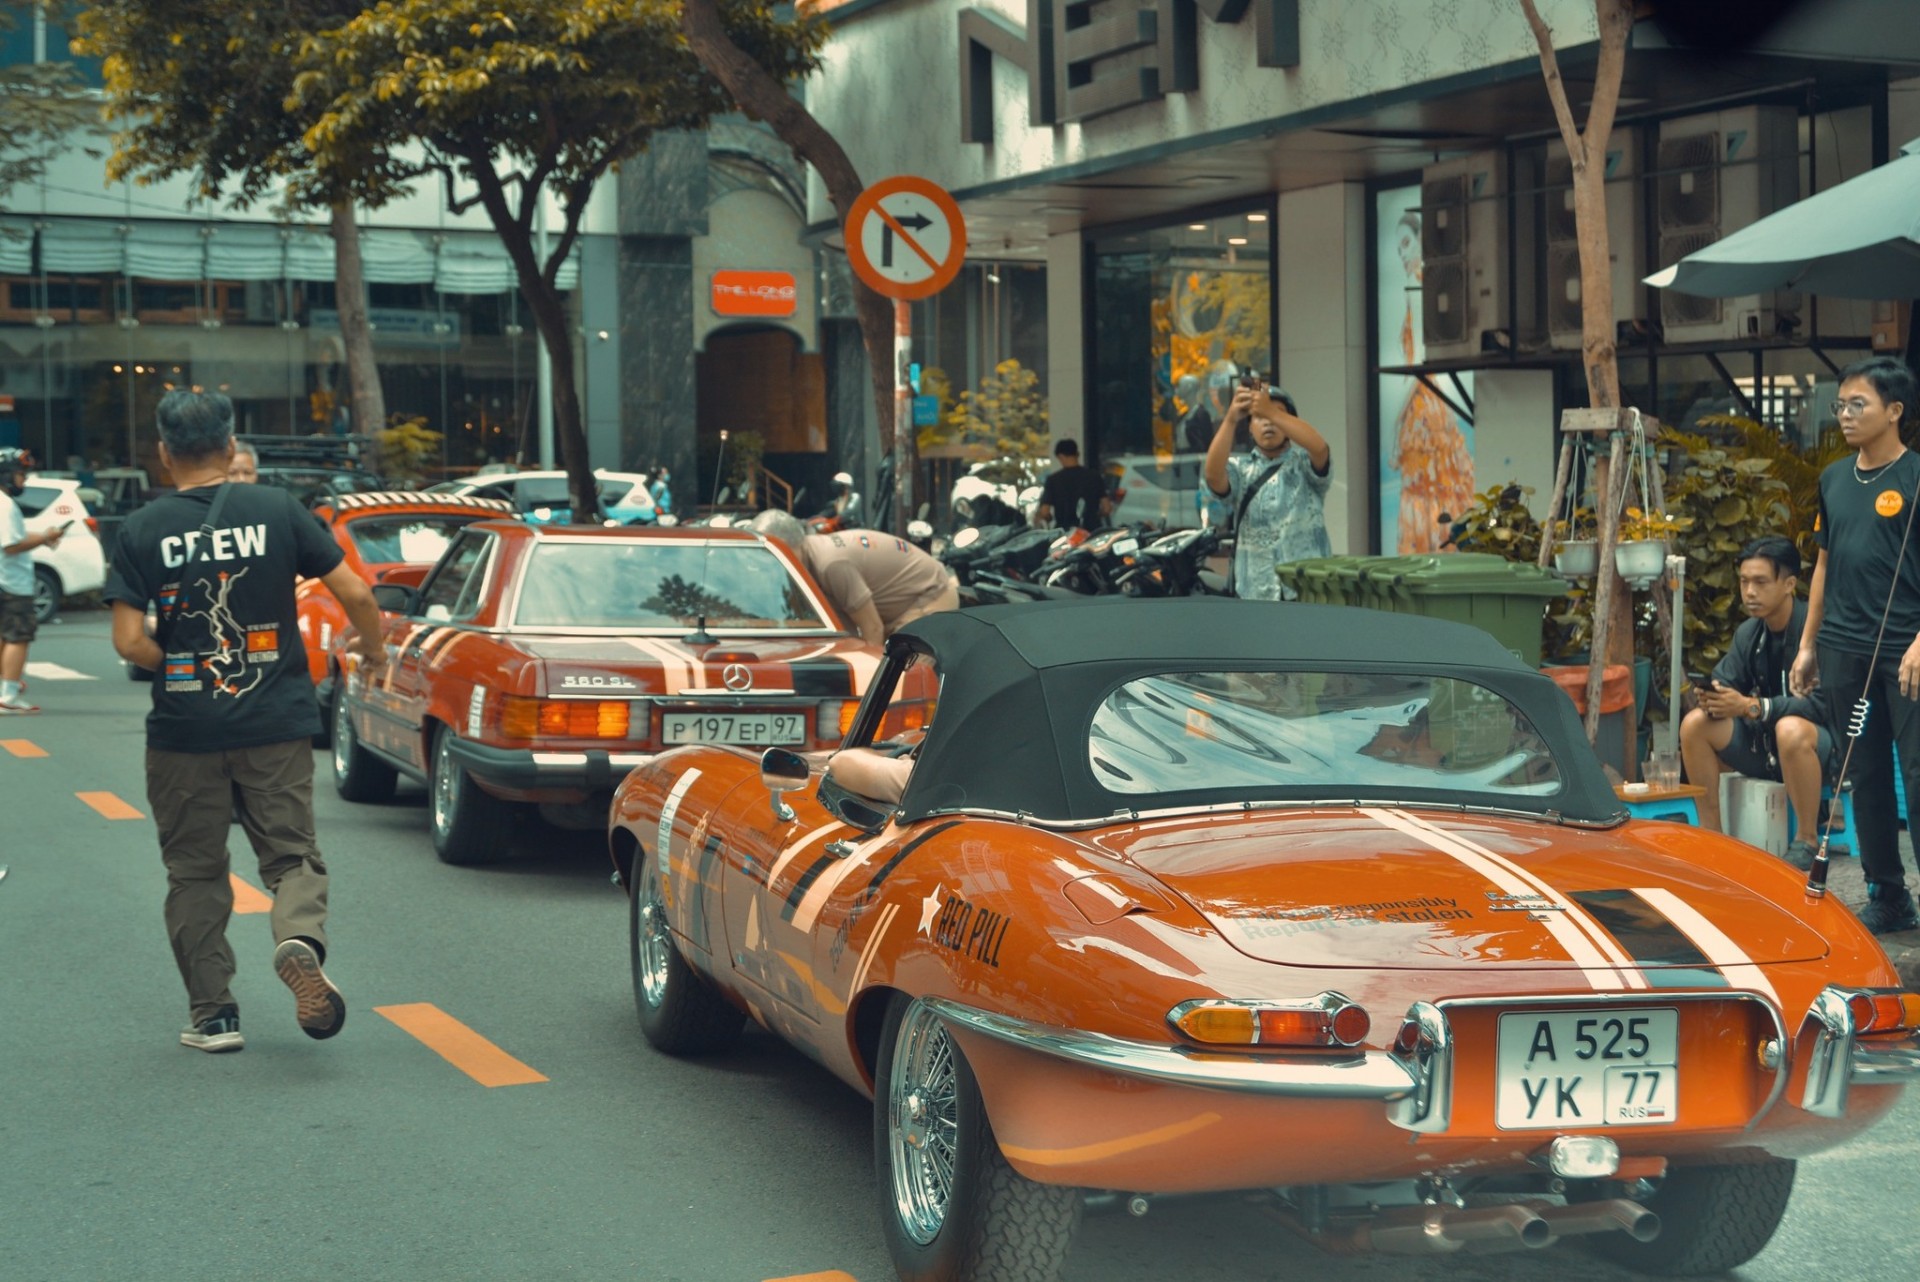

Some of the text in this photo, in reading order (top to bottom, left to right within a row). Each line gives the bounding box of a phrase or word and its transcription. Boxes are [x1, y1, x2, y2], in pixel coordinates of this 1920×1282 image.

[160, 524, 266, 568] CREW
[564, 676, 604, 687] 560
[1336, 896, 1457, 912] responsibly
[936, 895, 1011, 968] RED PILL
[1241, 914, 1340, 940] Report
[1385, 907, 1474, 923] stolen
[1575, 1018, 1650, 1060] 525
[1621, 1071, 1660, 1104] 77
[1619, 1107, 1647, 1118] RUS
